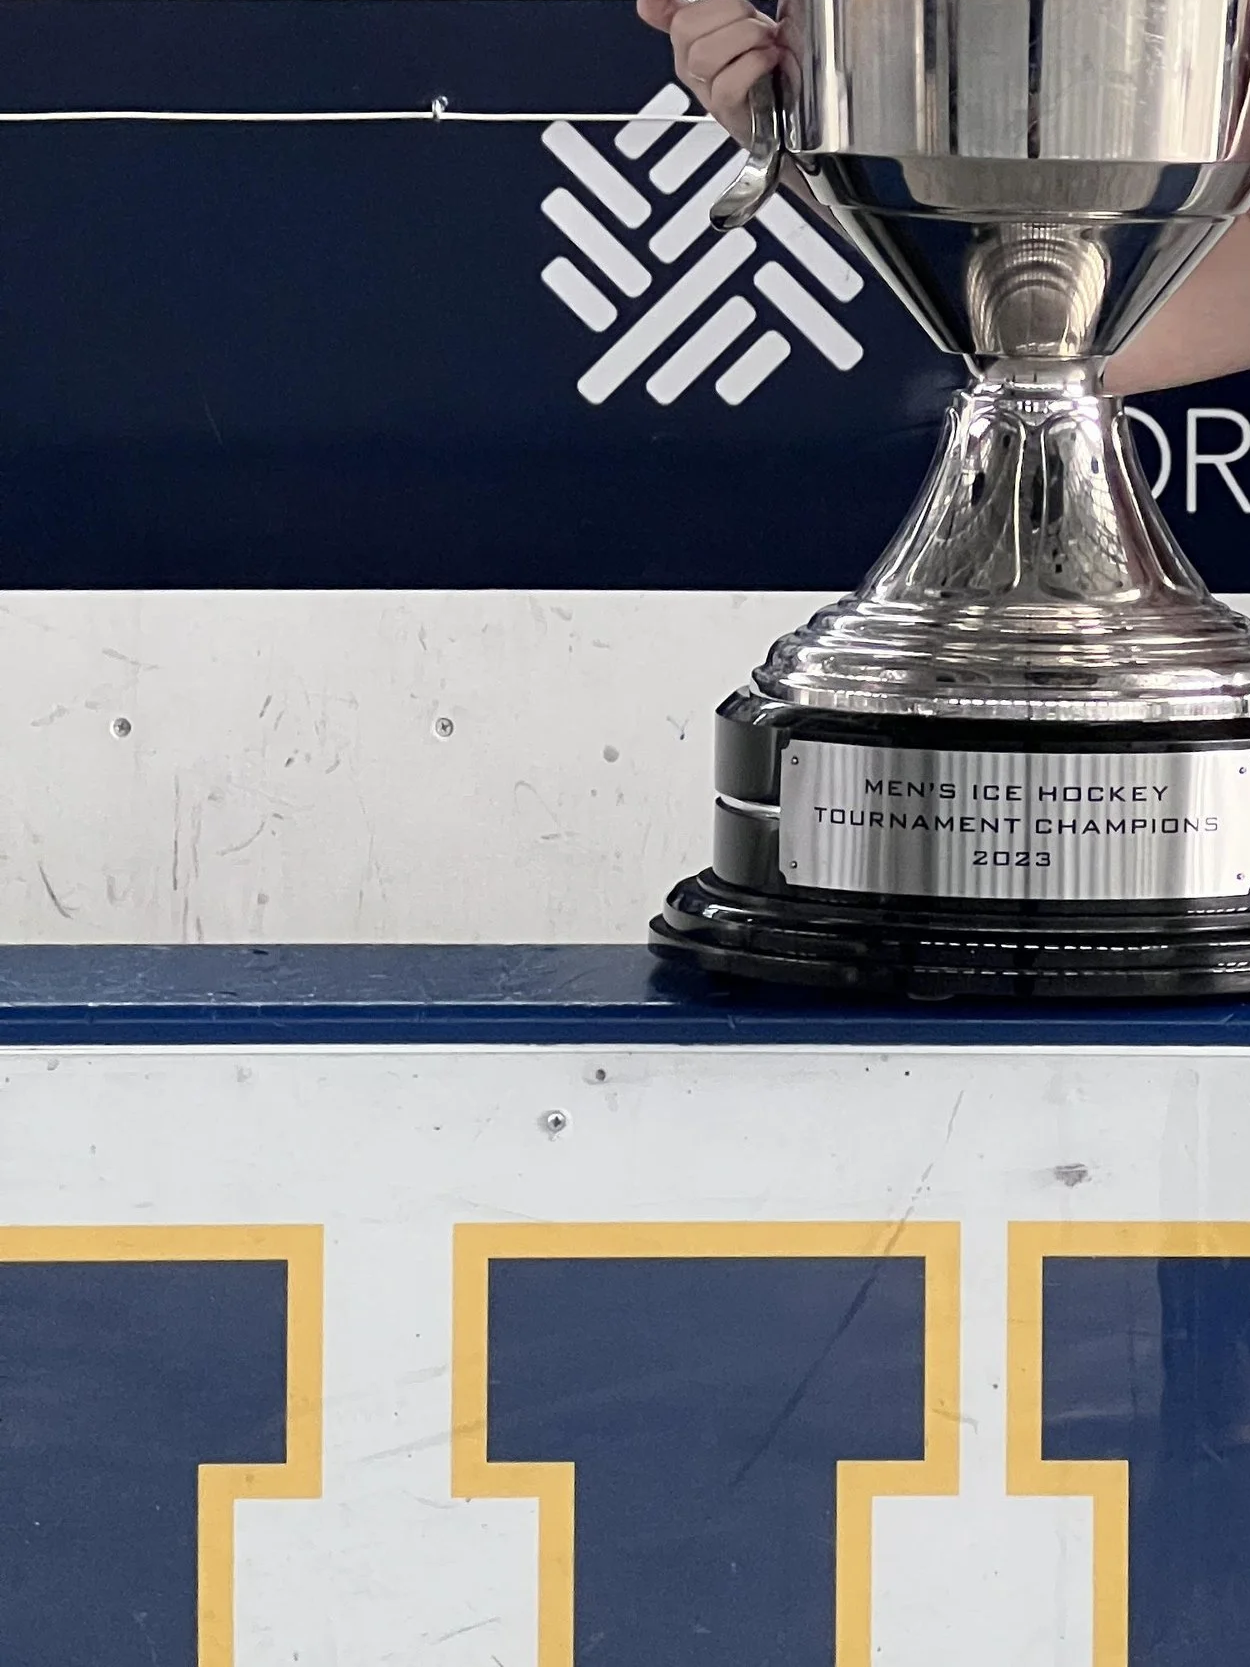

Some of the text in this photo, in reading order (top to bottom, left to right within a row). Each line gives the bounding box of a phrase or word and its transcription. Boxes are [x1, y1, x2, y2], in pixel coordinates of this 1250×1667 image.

[864, 778, 1169, 802] MEN'S ICE HOCKEY
[814, 806, 1218, 835] TOURNAMENT CHAMPIONS
[972, 850, 1051, 867] 2023
